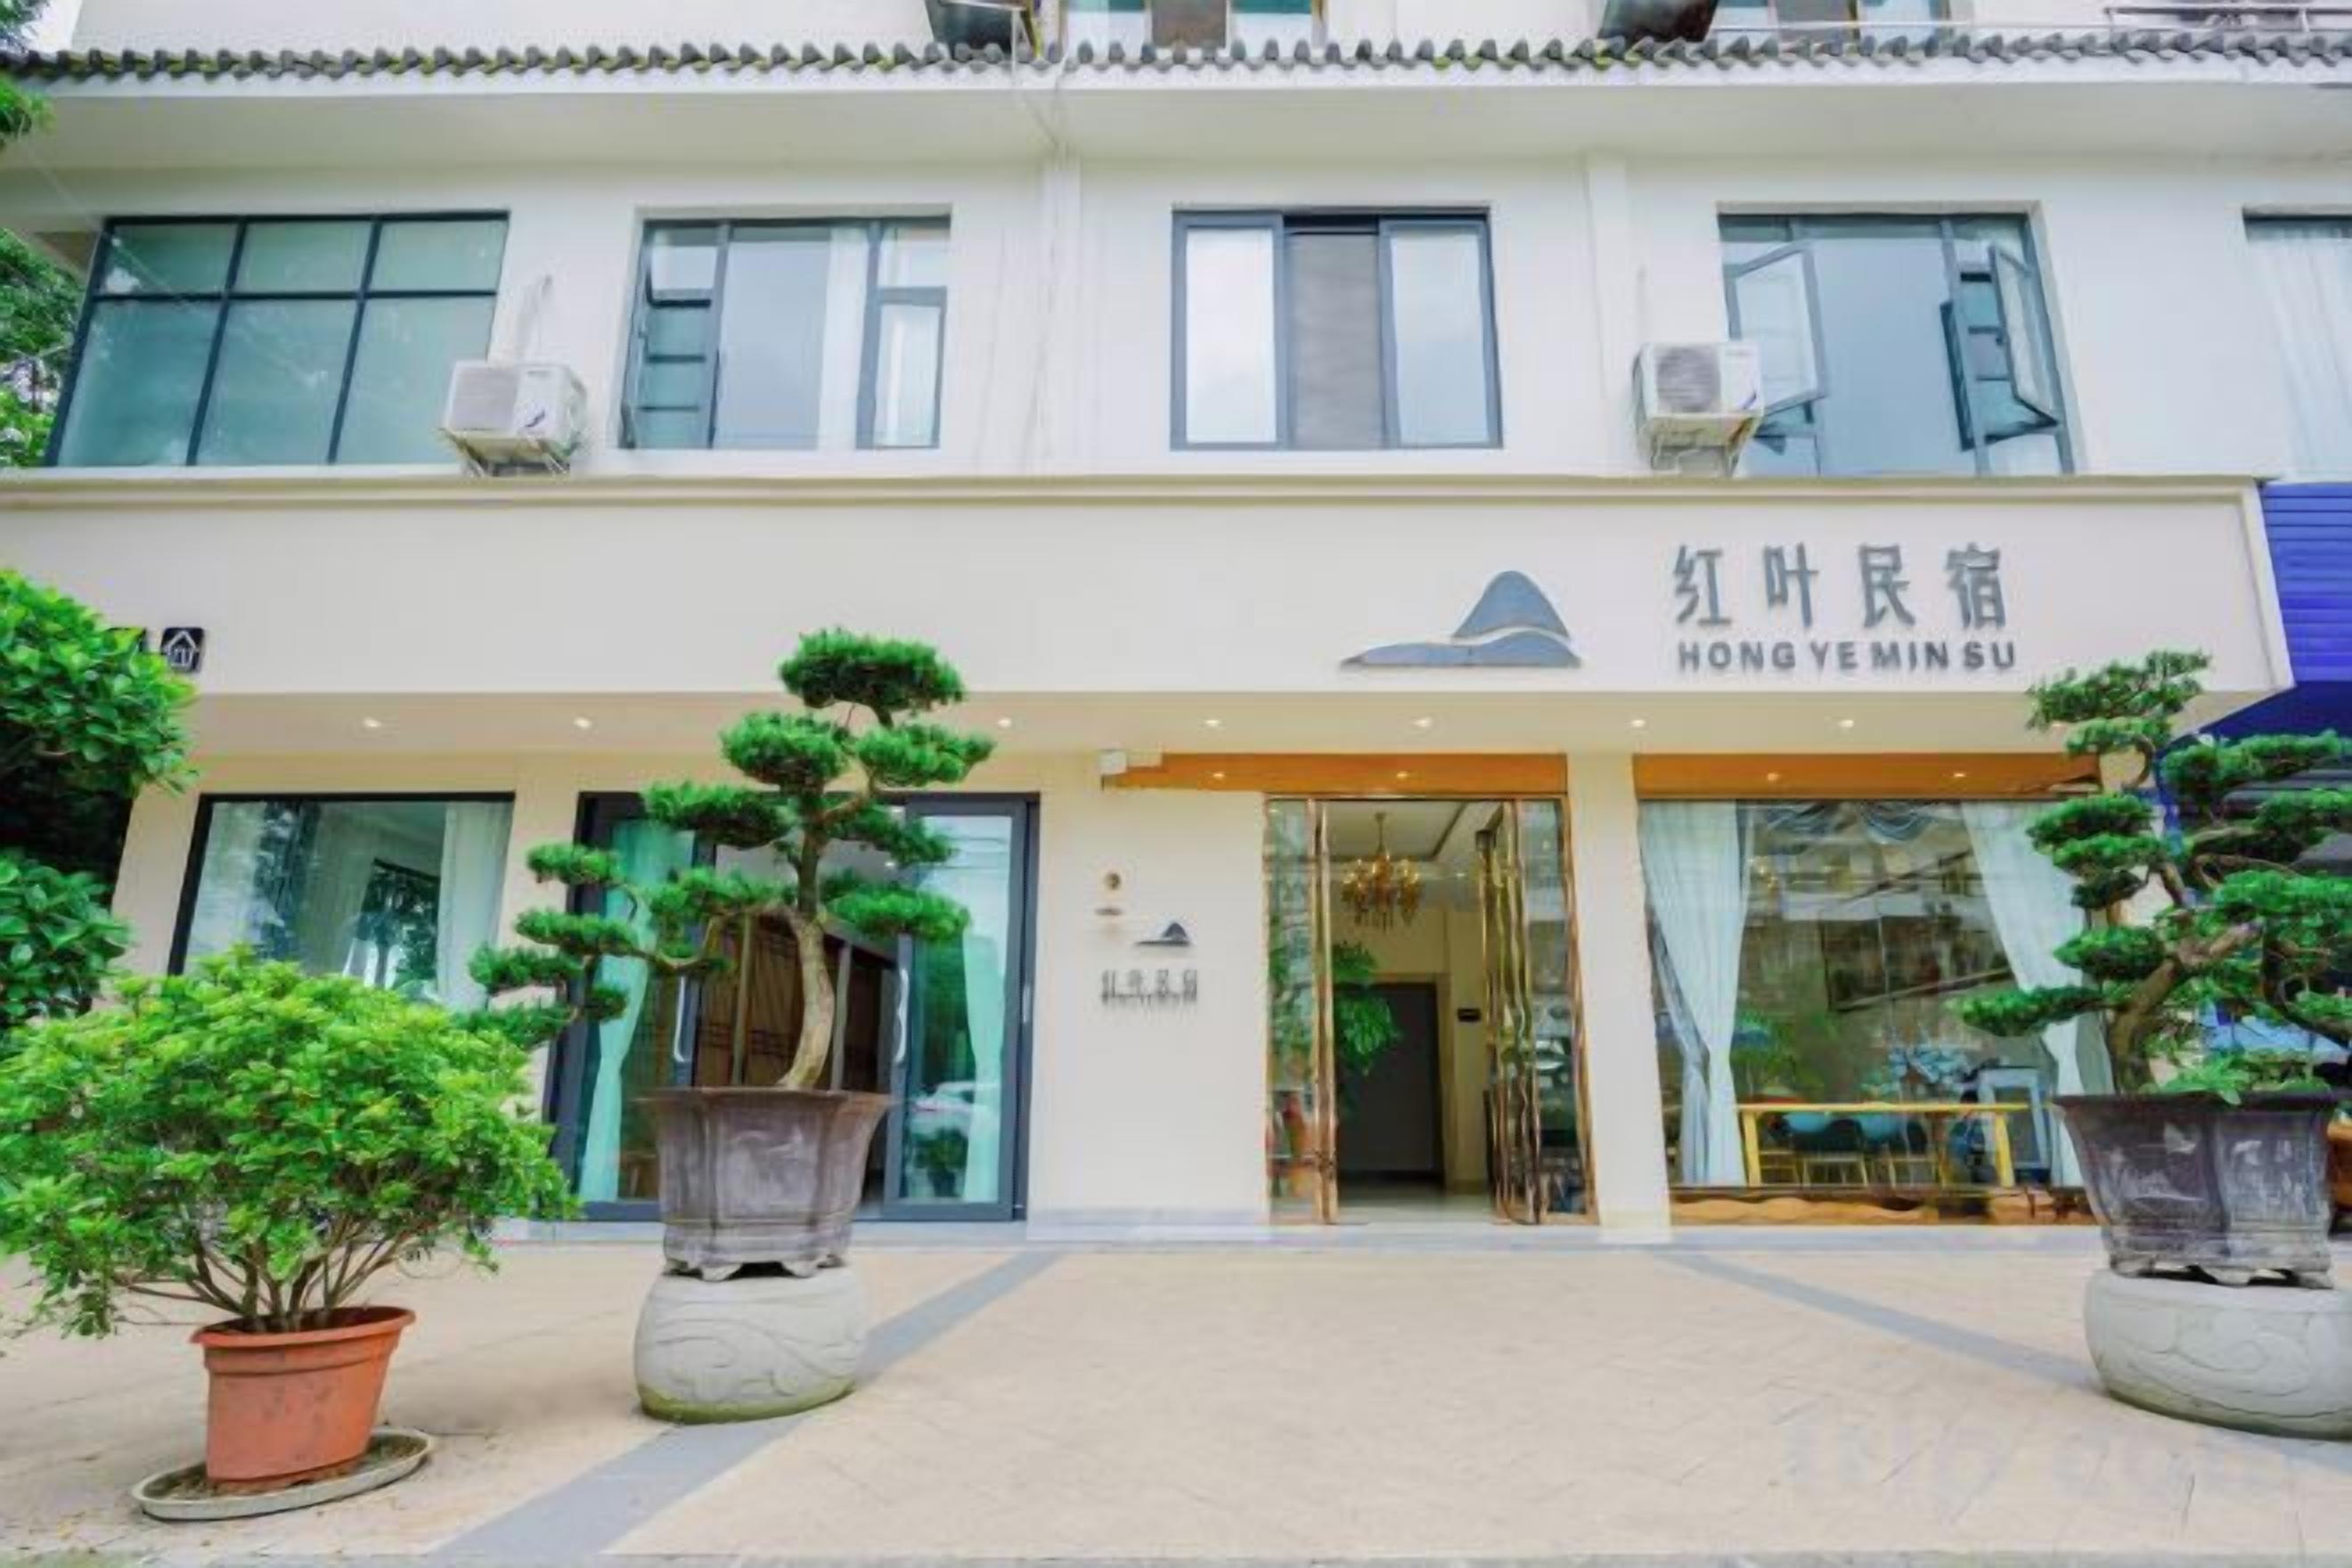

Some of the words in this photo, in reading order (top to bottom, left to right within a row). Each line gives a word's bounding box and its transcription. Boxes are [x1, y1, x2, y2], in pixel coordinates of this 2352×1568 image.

[1673, 542, 2007, 628] 红叶民宿
[1678, 641, 1796, 670] HONG
